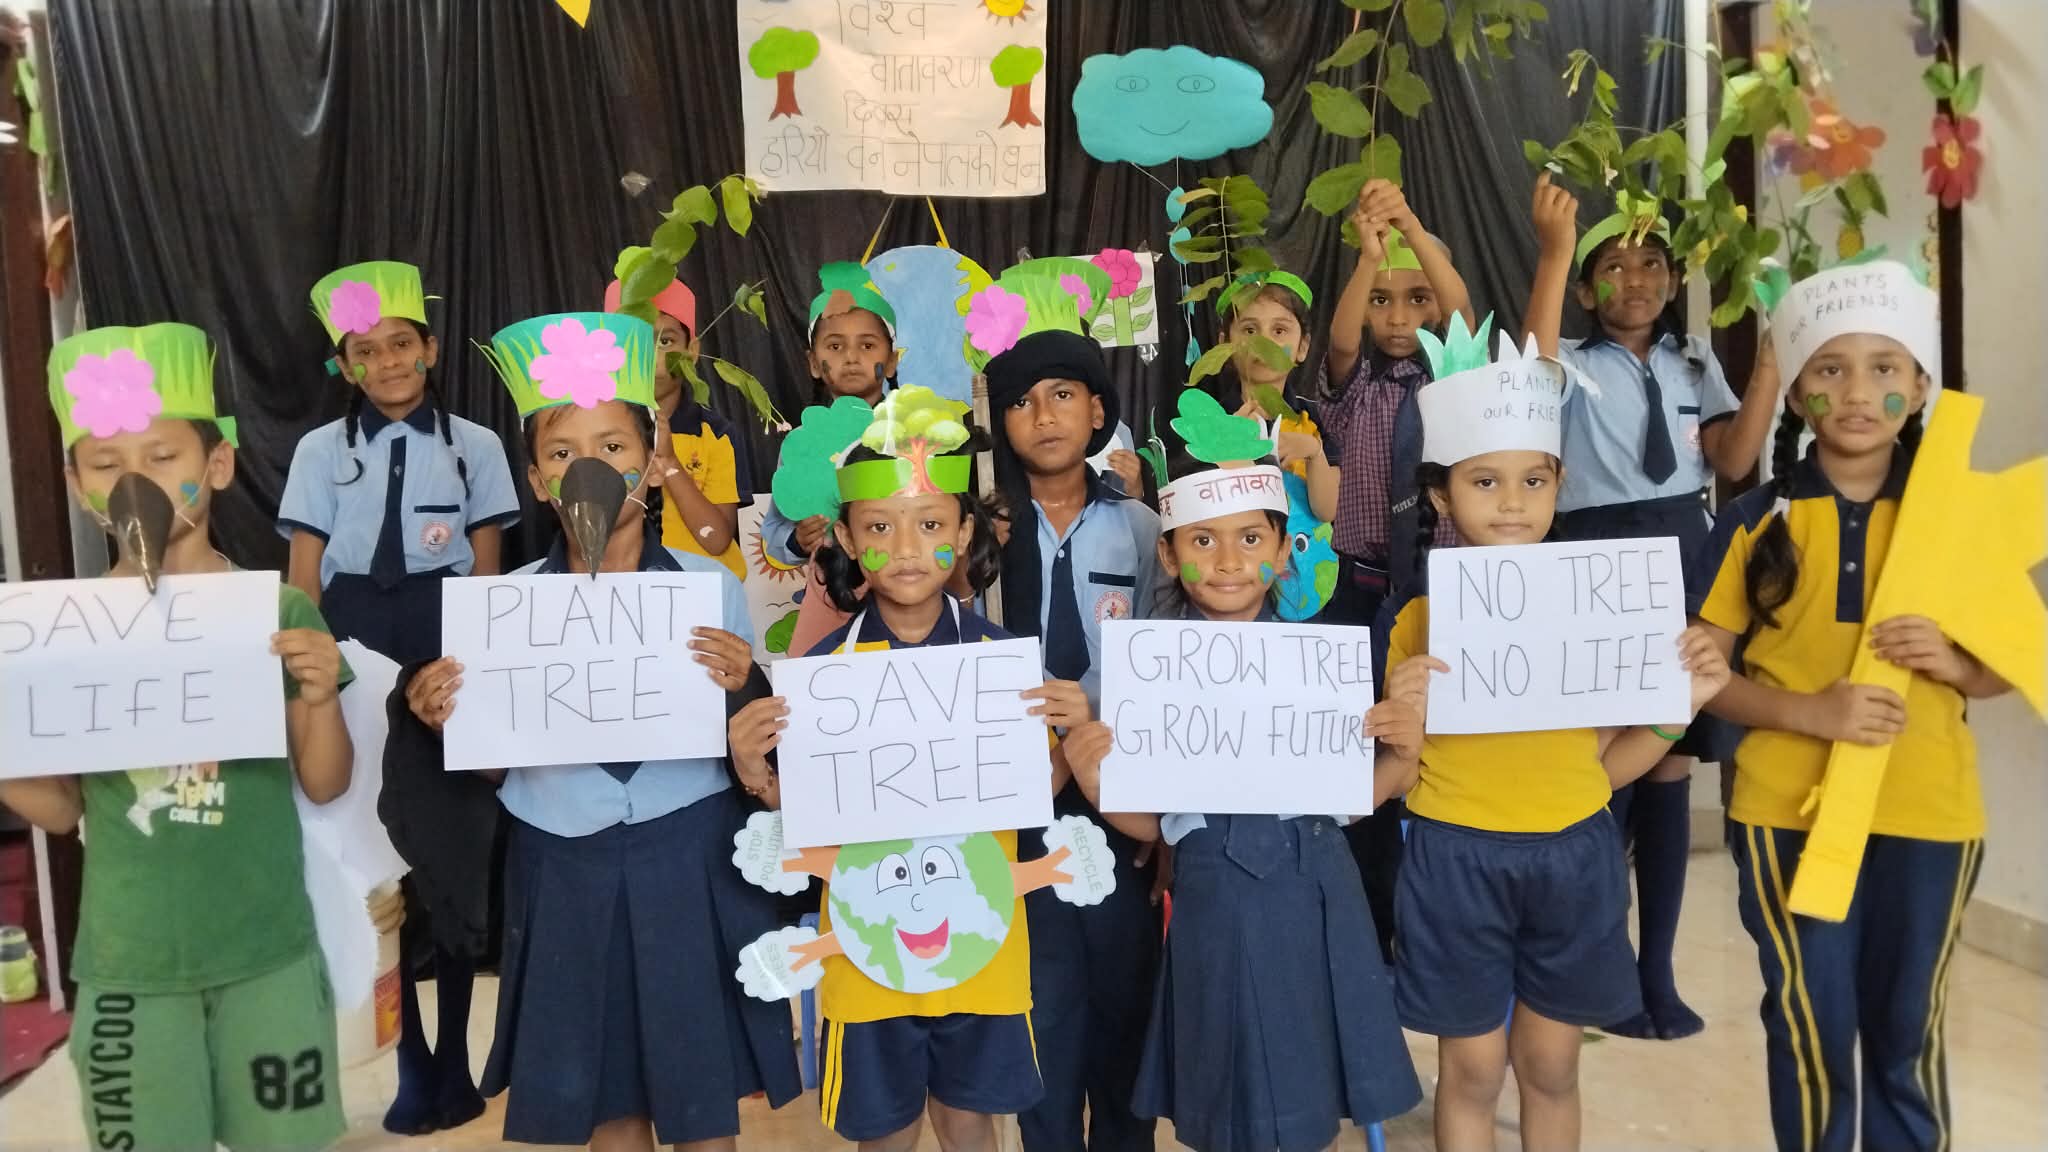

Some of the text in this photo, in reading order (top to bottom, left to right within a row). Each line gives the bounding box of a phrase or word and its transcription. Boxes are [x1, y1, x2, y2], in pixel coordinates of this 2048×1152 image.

[1804, 273, 1888, 304] PLANTS
[1816, 295, 1899, 320] FRIENDS
[1483, 402, 1518, 421] OUR
[487, 584, 686, 650] PLANT
[1459, 550, 1668, 621] NO TREE
[0, 591, 204, 653] SAVE
[481, 655, 671, 731] TREE
[1128, 628, 1373, 692] GROW TREE
[1462, 633, 1664, 702] NO LIFE
[29, 670, 214, 737] LIFE
[808, 655, 1025, 736] SAVE
[1115, 699, 1246, 759] GROW
[174, 781, 225, 808] TEAM
[810, 733, 1018, 814] TREE
[746, 829, 764, 862] STOP
[1071, 824, 1104, 895] RECYCLE
[250, 1046, 325, 1113] 82
